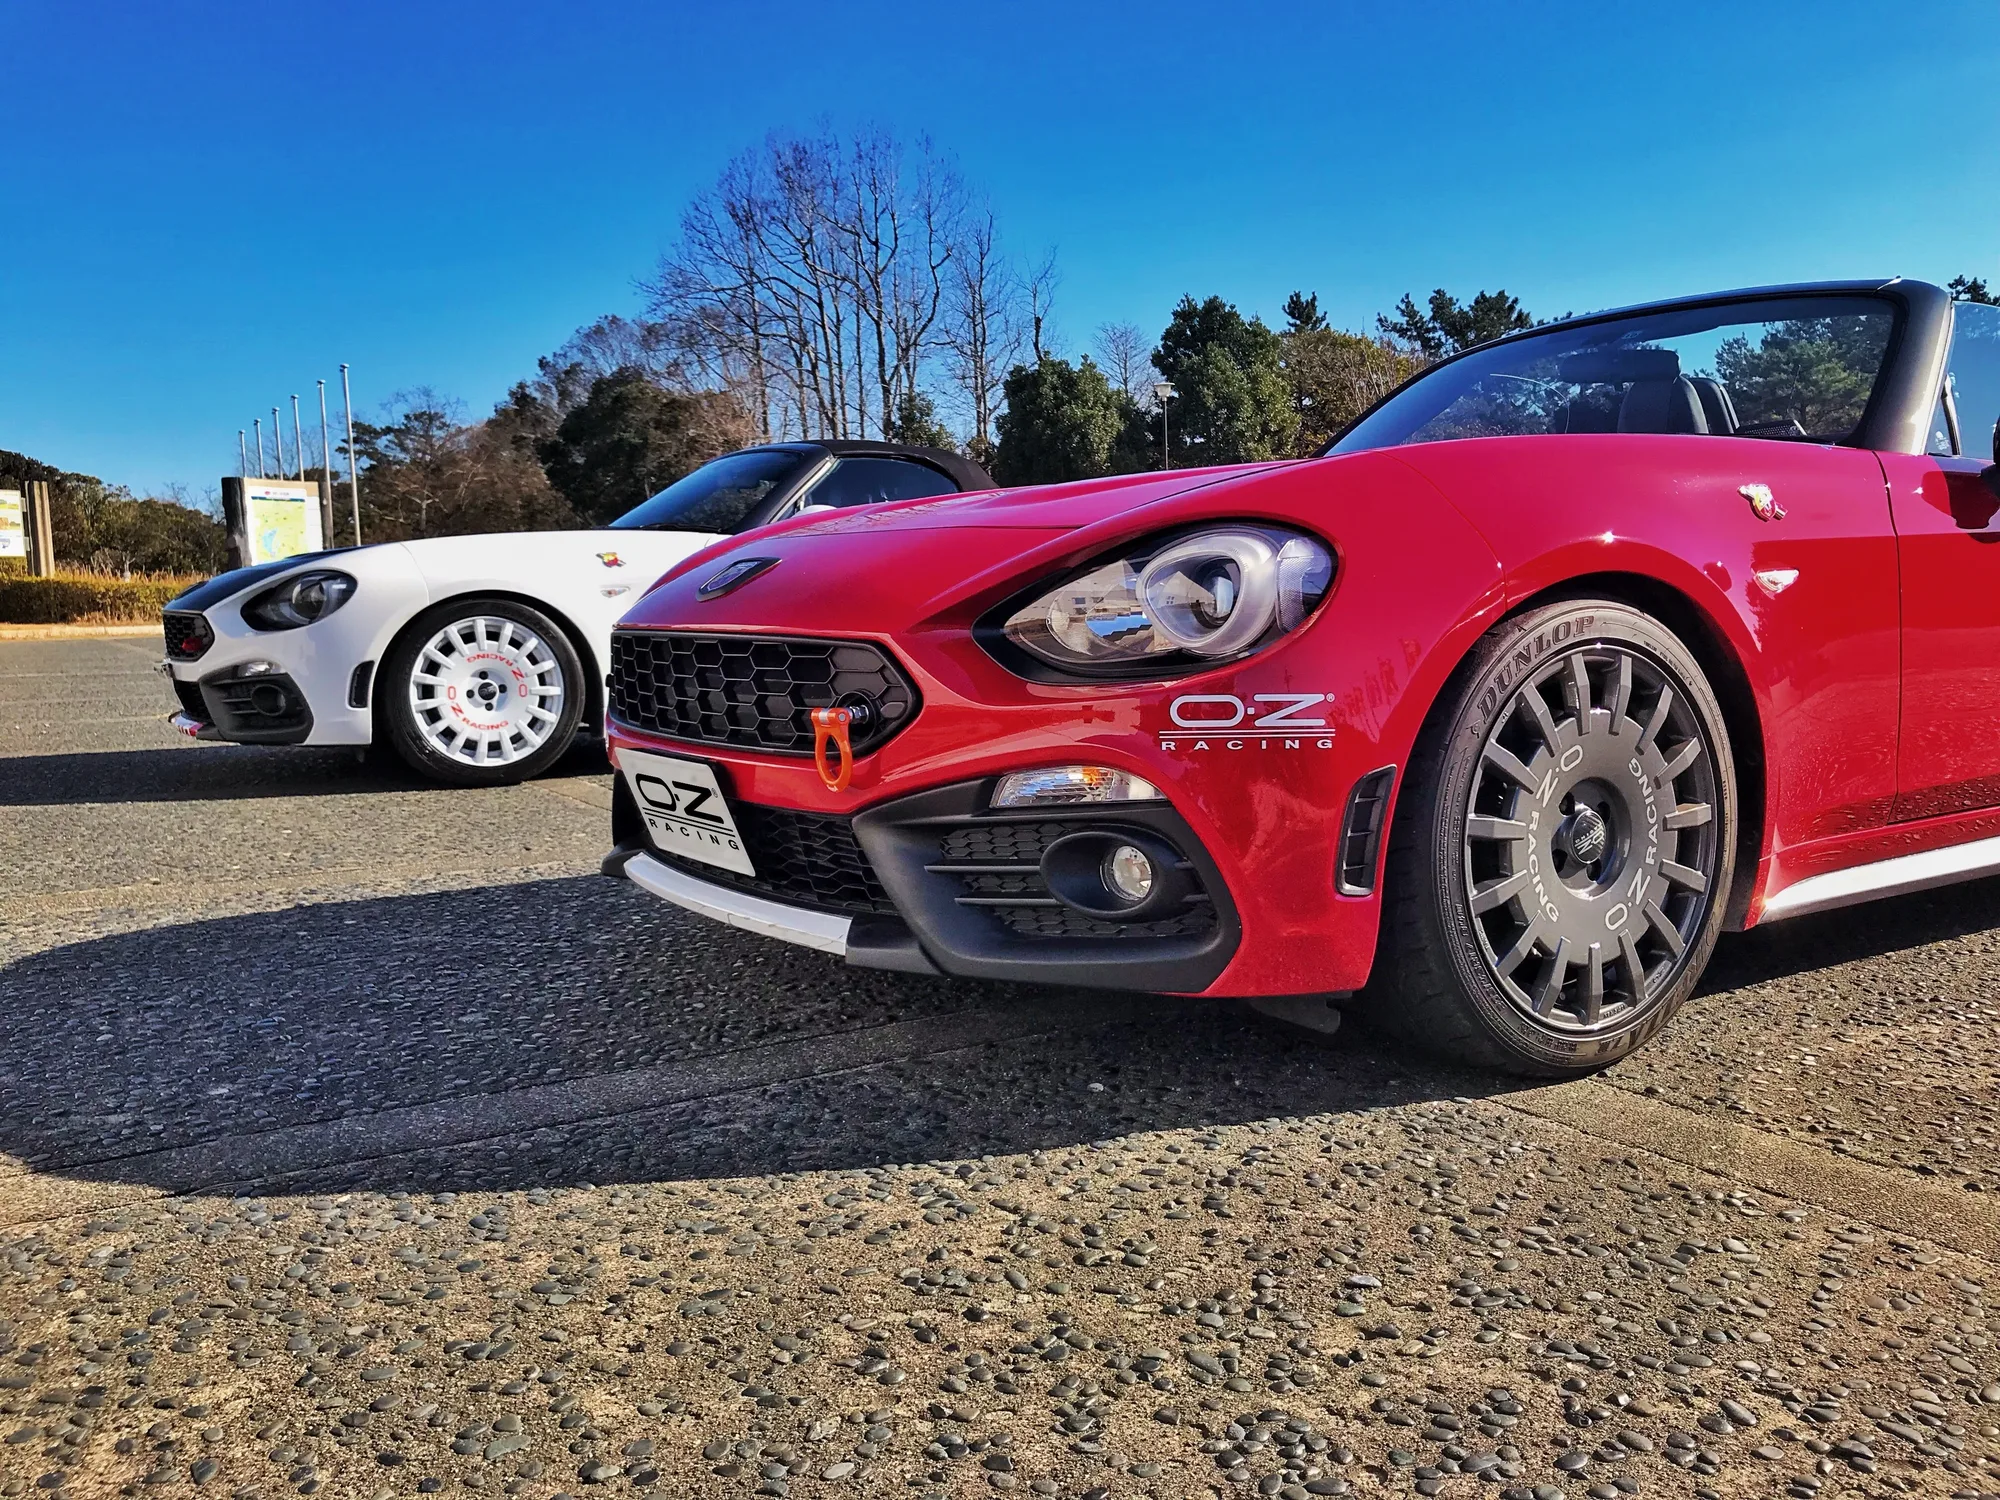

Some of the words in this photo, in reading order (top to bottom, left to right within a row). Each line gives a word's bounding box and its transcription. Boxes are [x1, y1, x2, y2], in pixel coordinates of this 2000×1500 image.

[466, 652, 514, 667] RACING
[1477, 615, 1595, 724] DUNLOP
[462, 716, 509, 731] RACING
[1161, 739, 1333, 751] RACING
[1628, 757, 1659, 865] RACING
[648, 818, 740, 851] RACING
[1528, 810, 1559, 923] RACING
